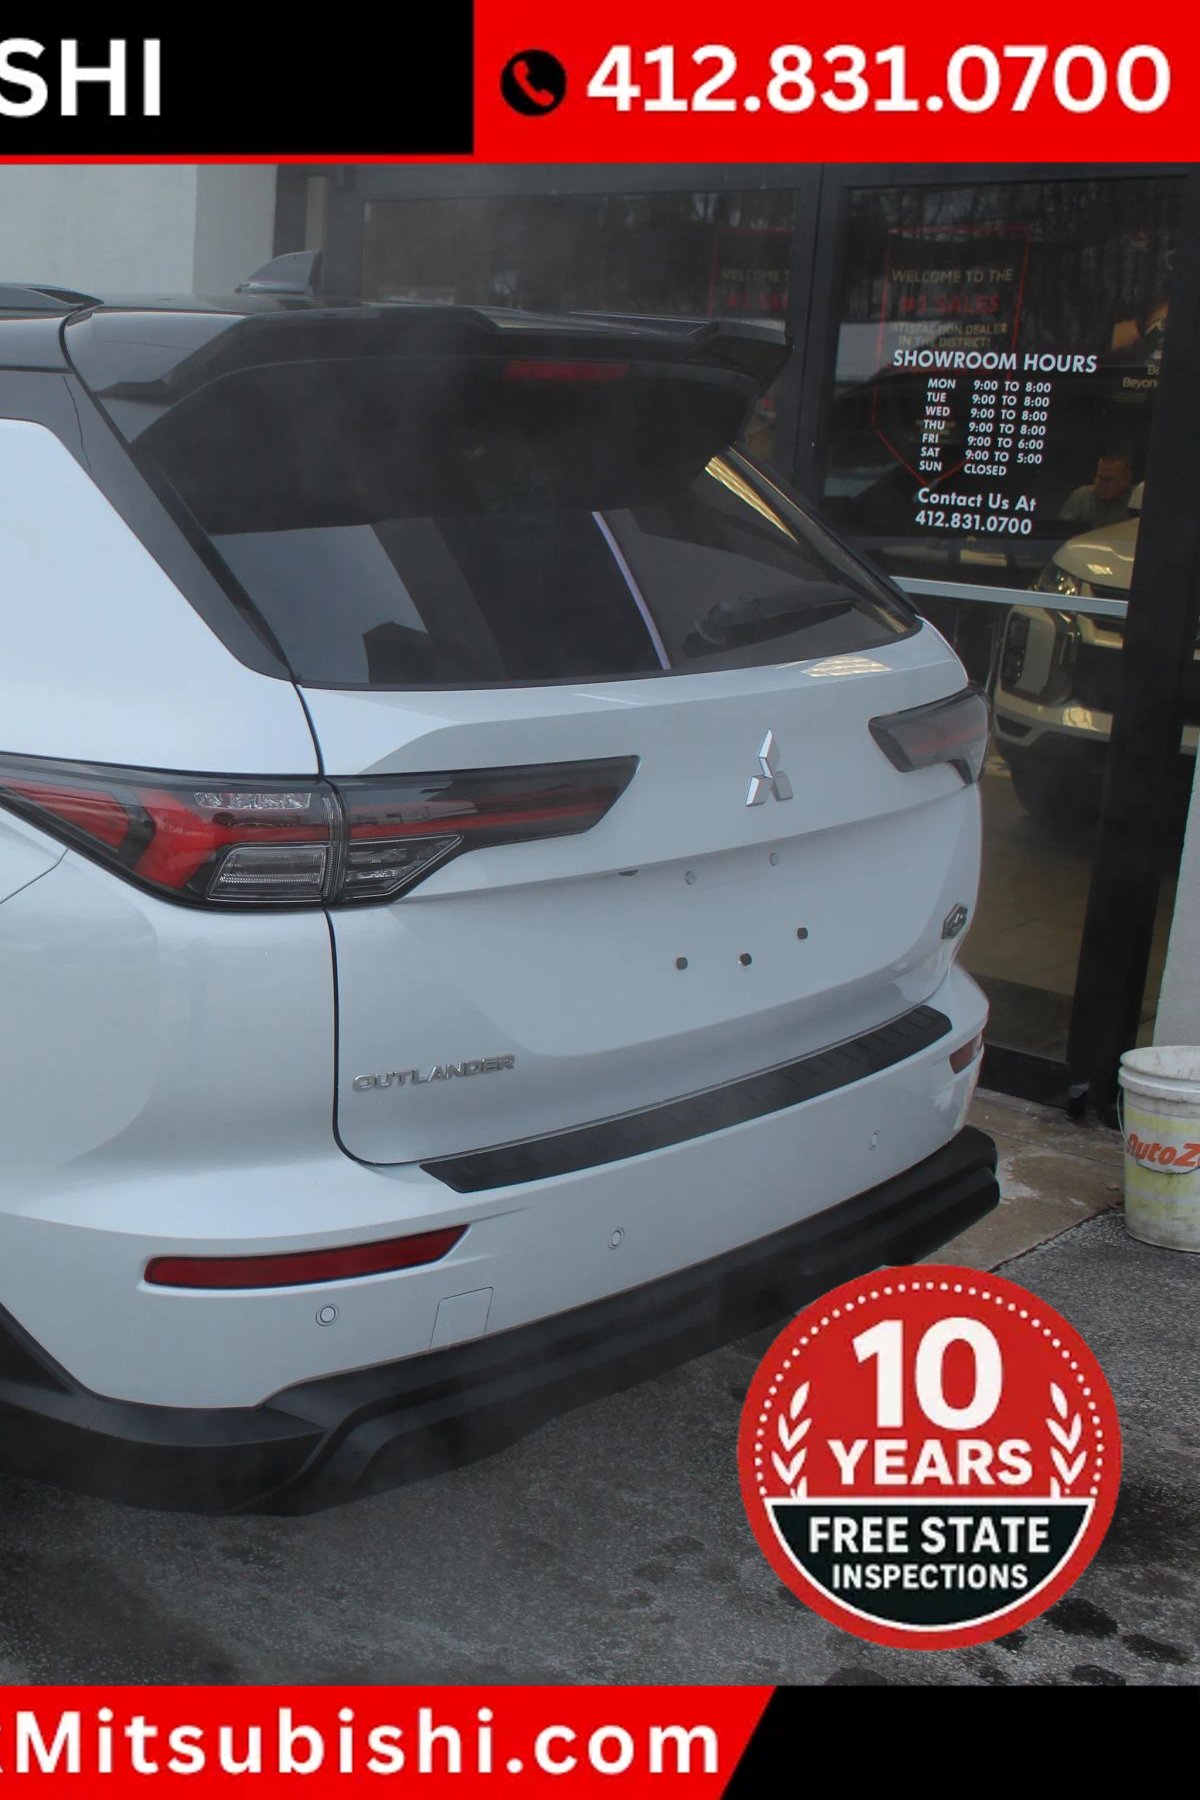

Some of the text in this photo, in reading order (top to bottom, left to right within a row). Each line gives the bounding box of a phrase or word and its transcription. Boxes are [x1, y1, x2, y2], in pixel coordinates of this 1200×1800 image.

[891, 268, 1015, 283] WELCOME TO THE
[965, 322, 1008, 335] DEALER
[892, 350, 1098, 373] SHOWROOM HOURS
[927, 378, 1052, 393] MON 9:00 TO 8:00
[926, 391, 1050, 408] TUE 9:00 TO 8:00
[925, 405, 1048, 422] WED 9:00 TO 8:00
[923, 419, 946, 431] THU
[968, 421, 994, 433] 9:00
[999, 423, 1015, 435] TO
[1020, 424, 1046, 436] 8:00
[922, 432, 1044, 450] FRI 9:00 TO 6:00
[920, 446, 1043, 465] SAT 9:00 TO 5:00
[919, 460, 1007, 476] SUN CLOSED
[918, 487, 1037, 512] Contact Us At
[915, 510, 1033, 535] 412.831.0700
[352, 1054, 516, 1091] OUTLANDER
[1125, 1133, 1200, 1168] AutoZ
